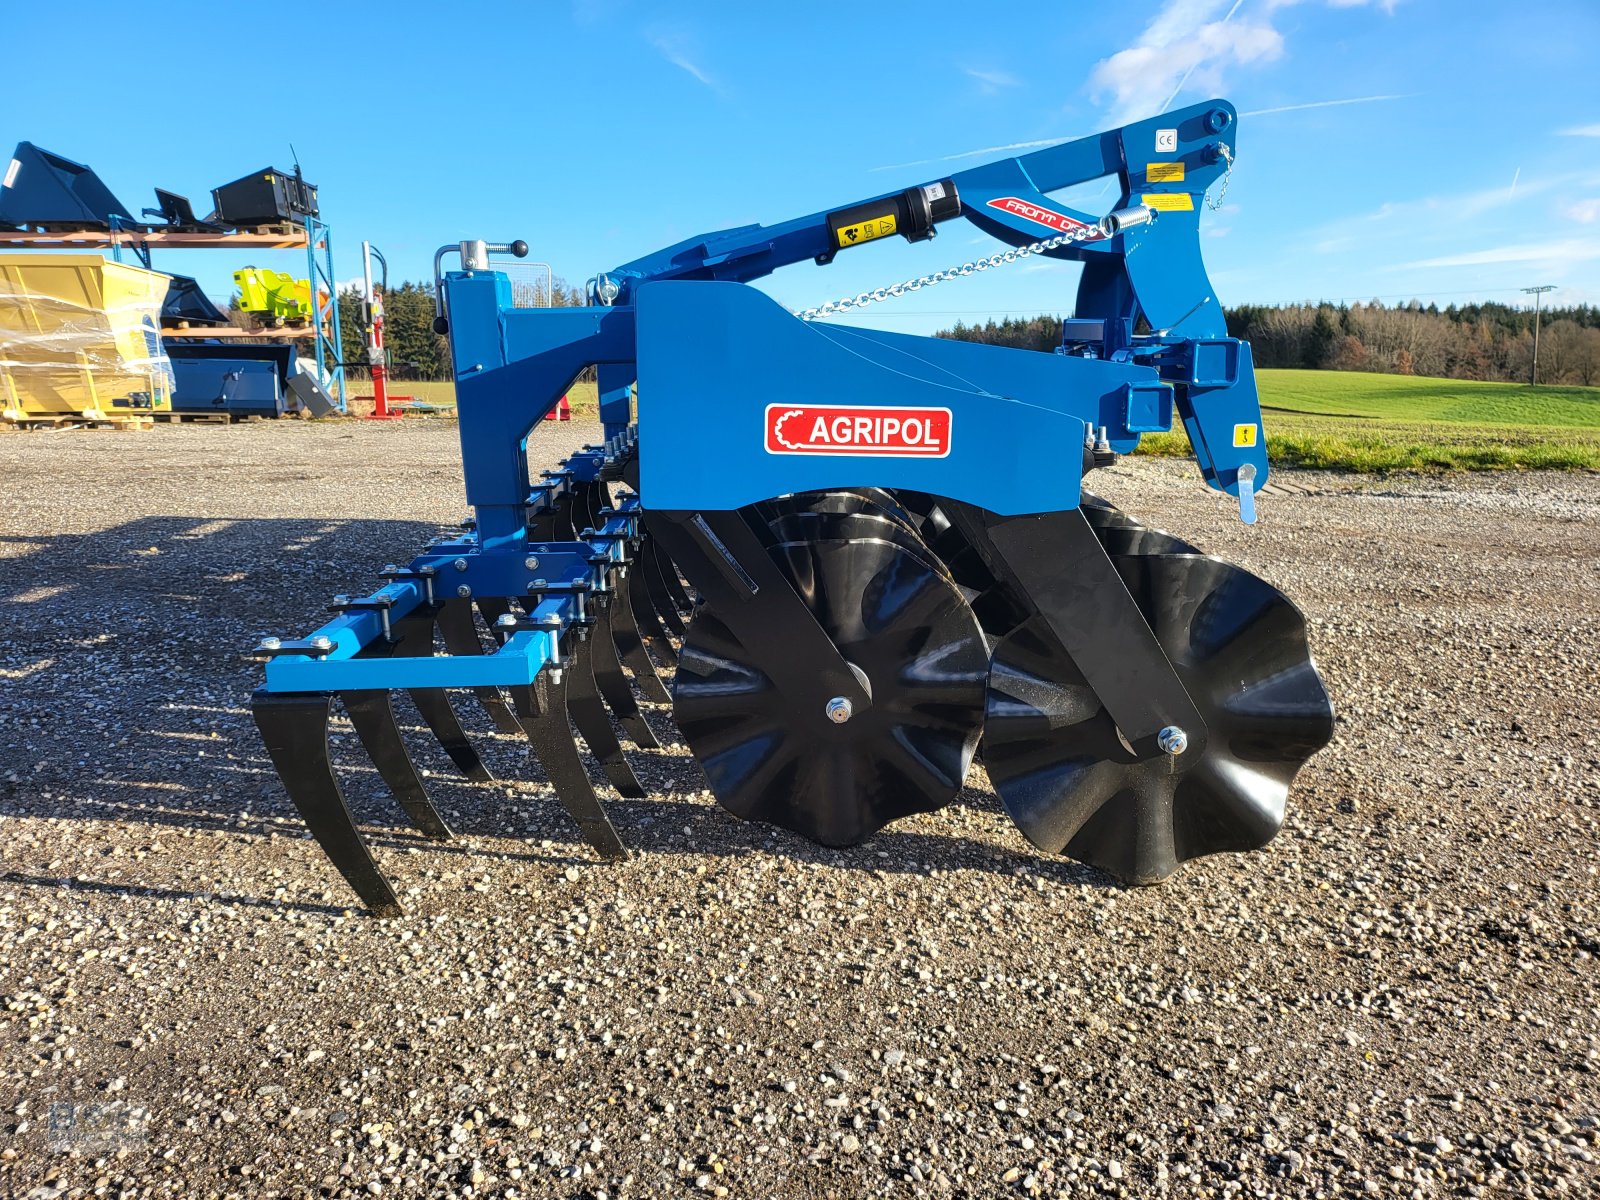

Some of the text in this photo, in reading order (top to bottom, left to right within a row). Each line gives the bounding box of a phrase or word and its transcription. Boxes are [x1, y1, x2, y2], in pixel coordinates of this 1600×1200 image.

[1159, 135, 1173, 146] CE
[1006, 200, 1057, 224] FRONT
[809, 416, 940, 445] AGRIPOL
